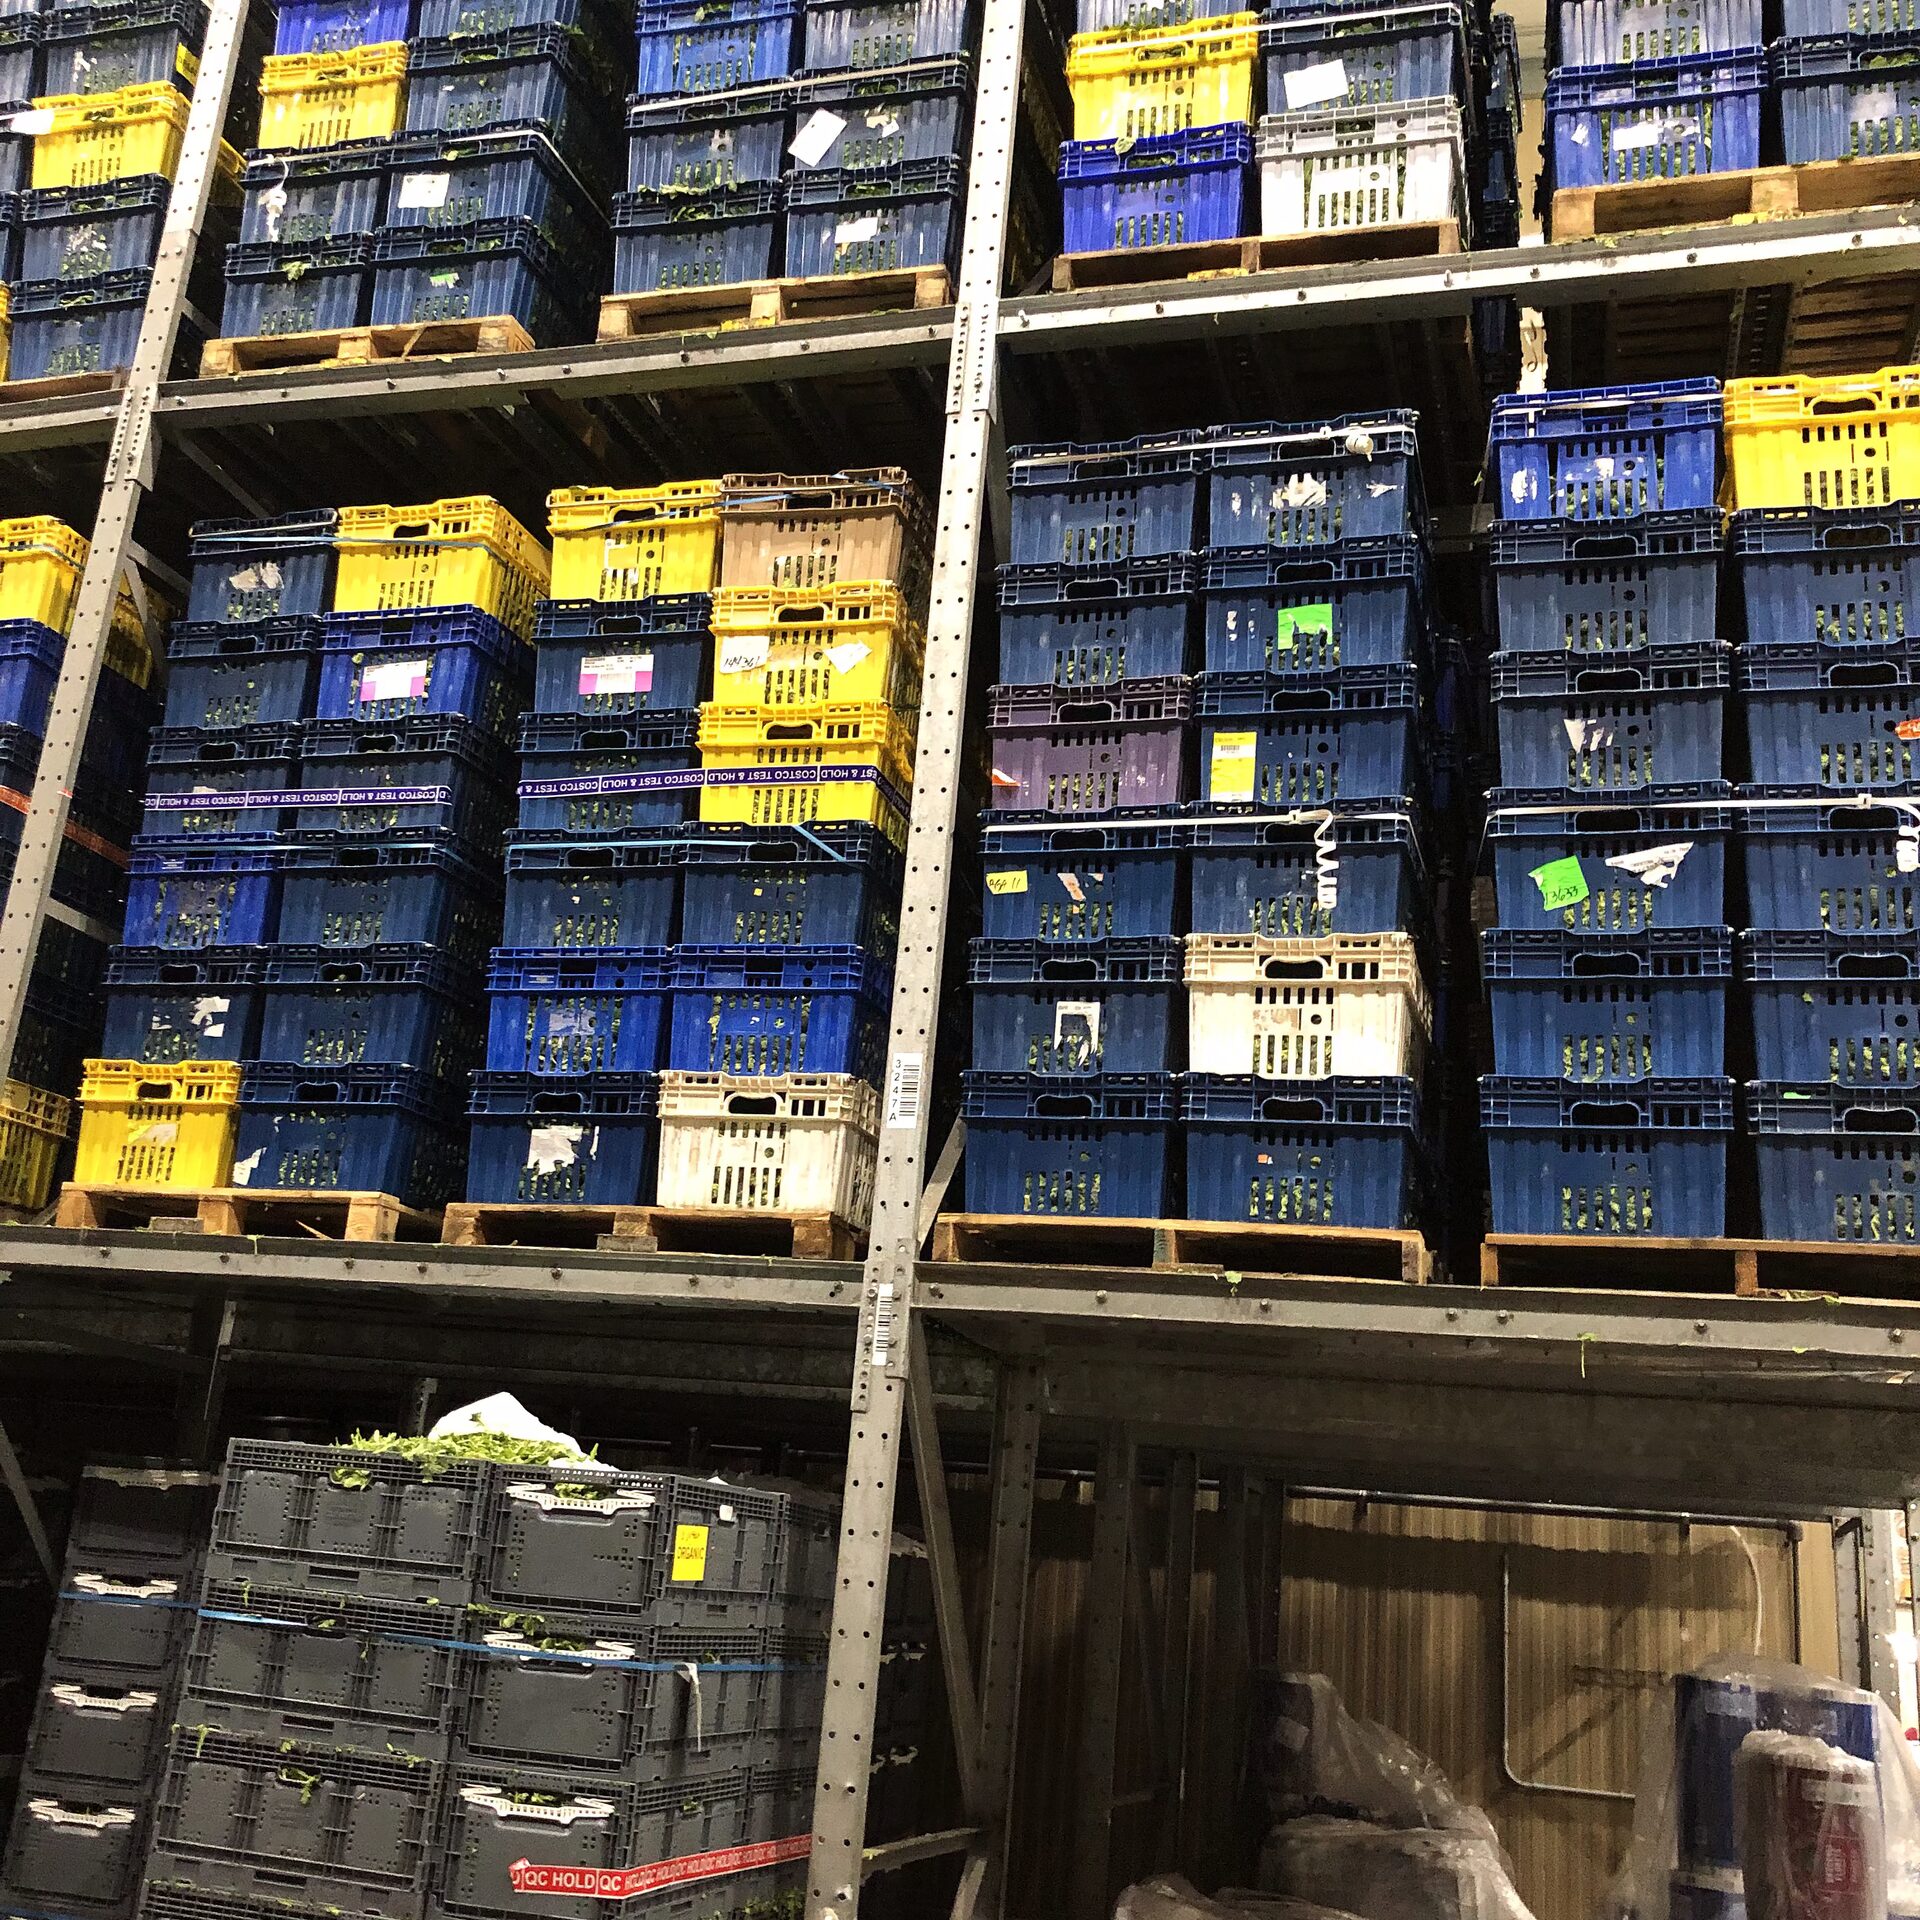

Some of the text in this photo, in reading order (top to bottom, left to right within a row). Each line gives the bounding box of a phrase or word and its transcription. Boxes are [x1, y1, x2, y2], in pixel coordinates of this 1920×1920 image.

[708, 772, 736, 782] HOLD
[739, 772, 746, 780] &
[747, 771, 773, 780] TEST
[775, 770, 816, 779] COSTCO
[821, 769, 849, 778] HOLD
[852, 769, 858, 778] &
[630, 779, 637, 787] &
[638, 777, 662, 786] TEST
[664, 774, 704, 784] COSTCO
[533, 784, 558, 793] TEST
[560, 782, 598, 792] COSTCO
[602, 780, 628, 788] HOLD
[248, 796, 270, 804] HOLD
[272, 795, 280, 803] &
[280, 794, 301, 803] TEST
[302, 794, 338, 802] COSTCO
[342, 793, 366, 801] HOLD
[375, 792, 397, 800] TEST
[398, 791, 436, 800] COSTCO
[160, 798, 182, 806] HOLD
[190, 798, 210, 806] TEST
[212, 796, 245, 805] COSTCO
[525, 1871, 548, 1887] QC
[552, 1872, 596, 1889] HOLD
[600, 1876, 622, 1892] QC
[624, 1872, 644, 1891] HOLD
